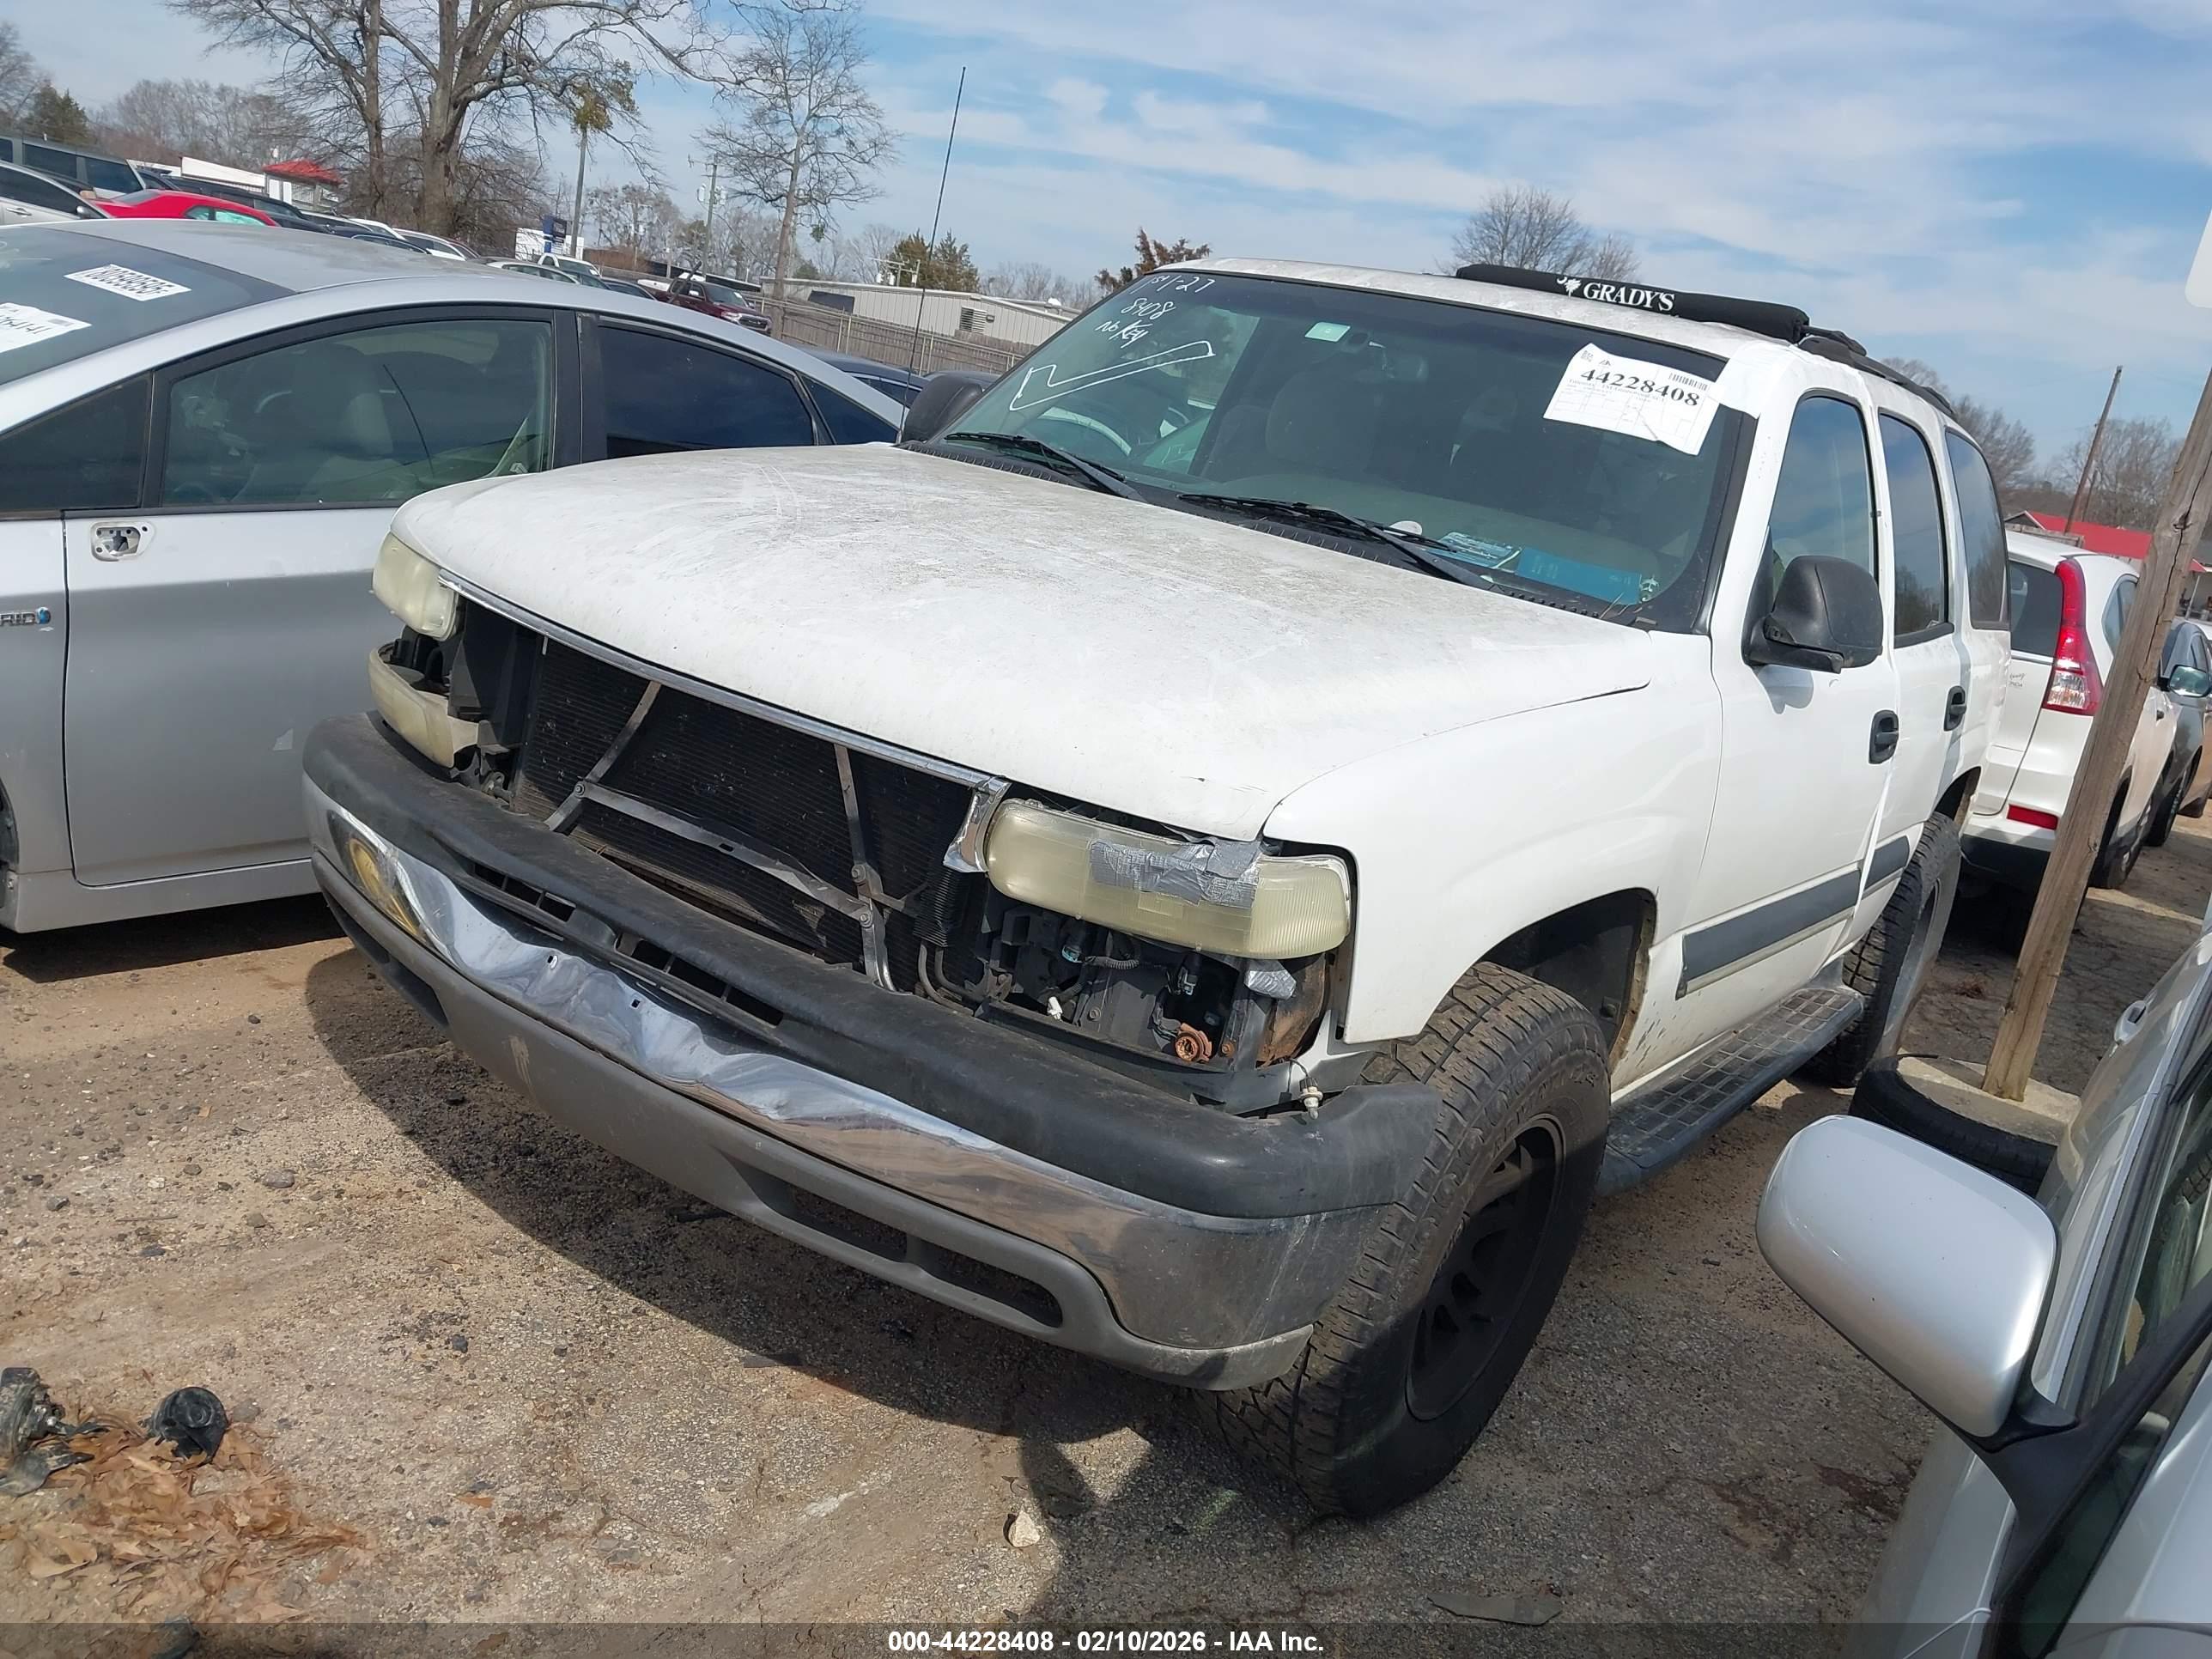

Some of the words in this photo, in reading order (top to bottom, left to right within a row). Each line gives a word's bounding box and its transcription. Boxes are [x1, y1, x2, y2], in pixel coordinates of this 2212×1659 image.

[1121, 298, 1176, 320] 8408
[1583, 282, 1675, 312] GRADY'S
[1580, 368, 1700, 406] 44228408
